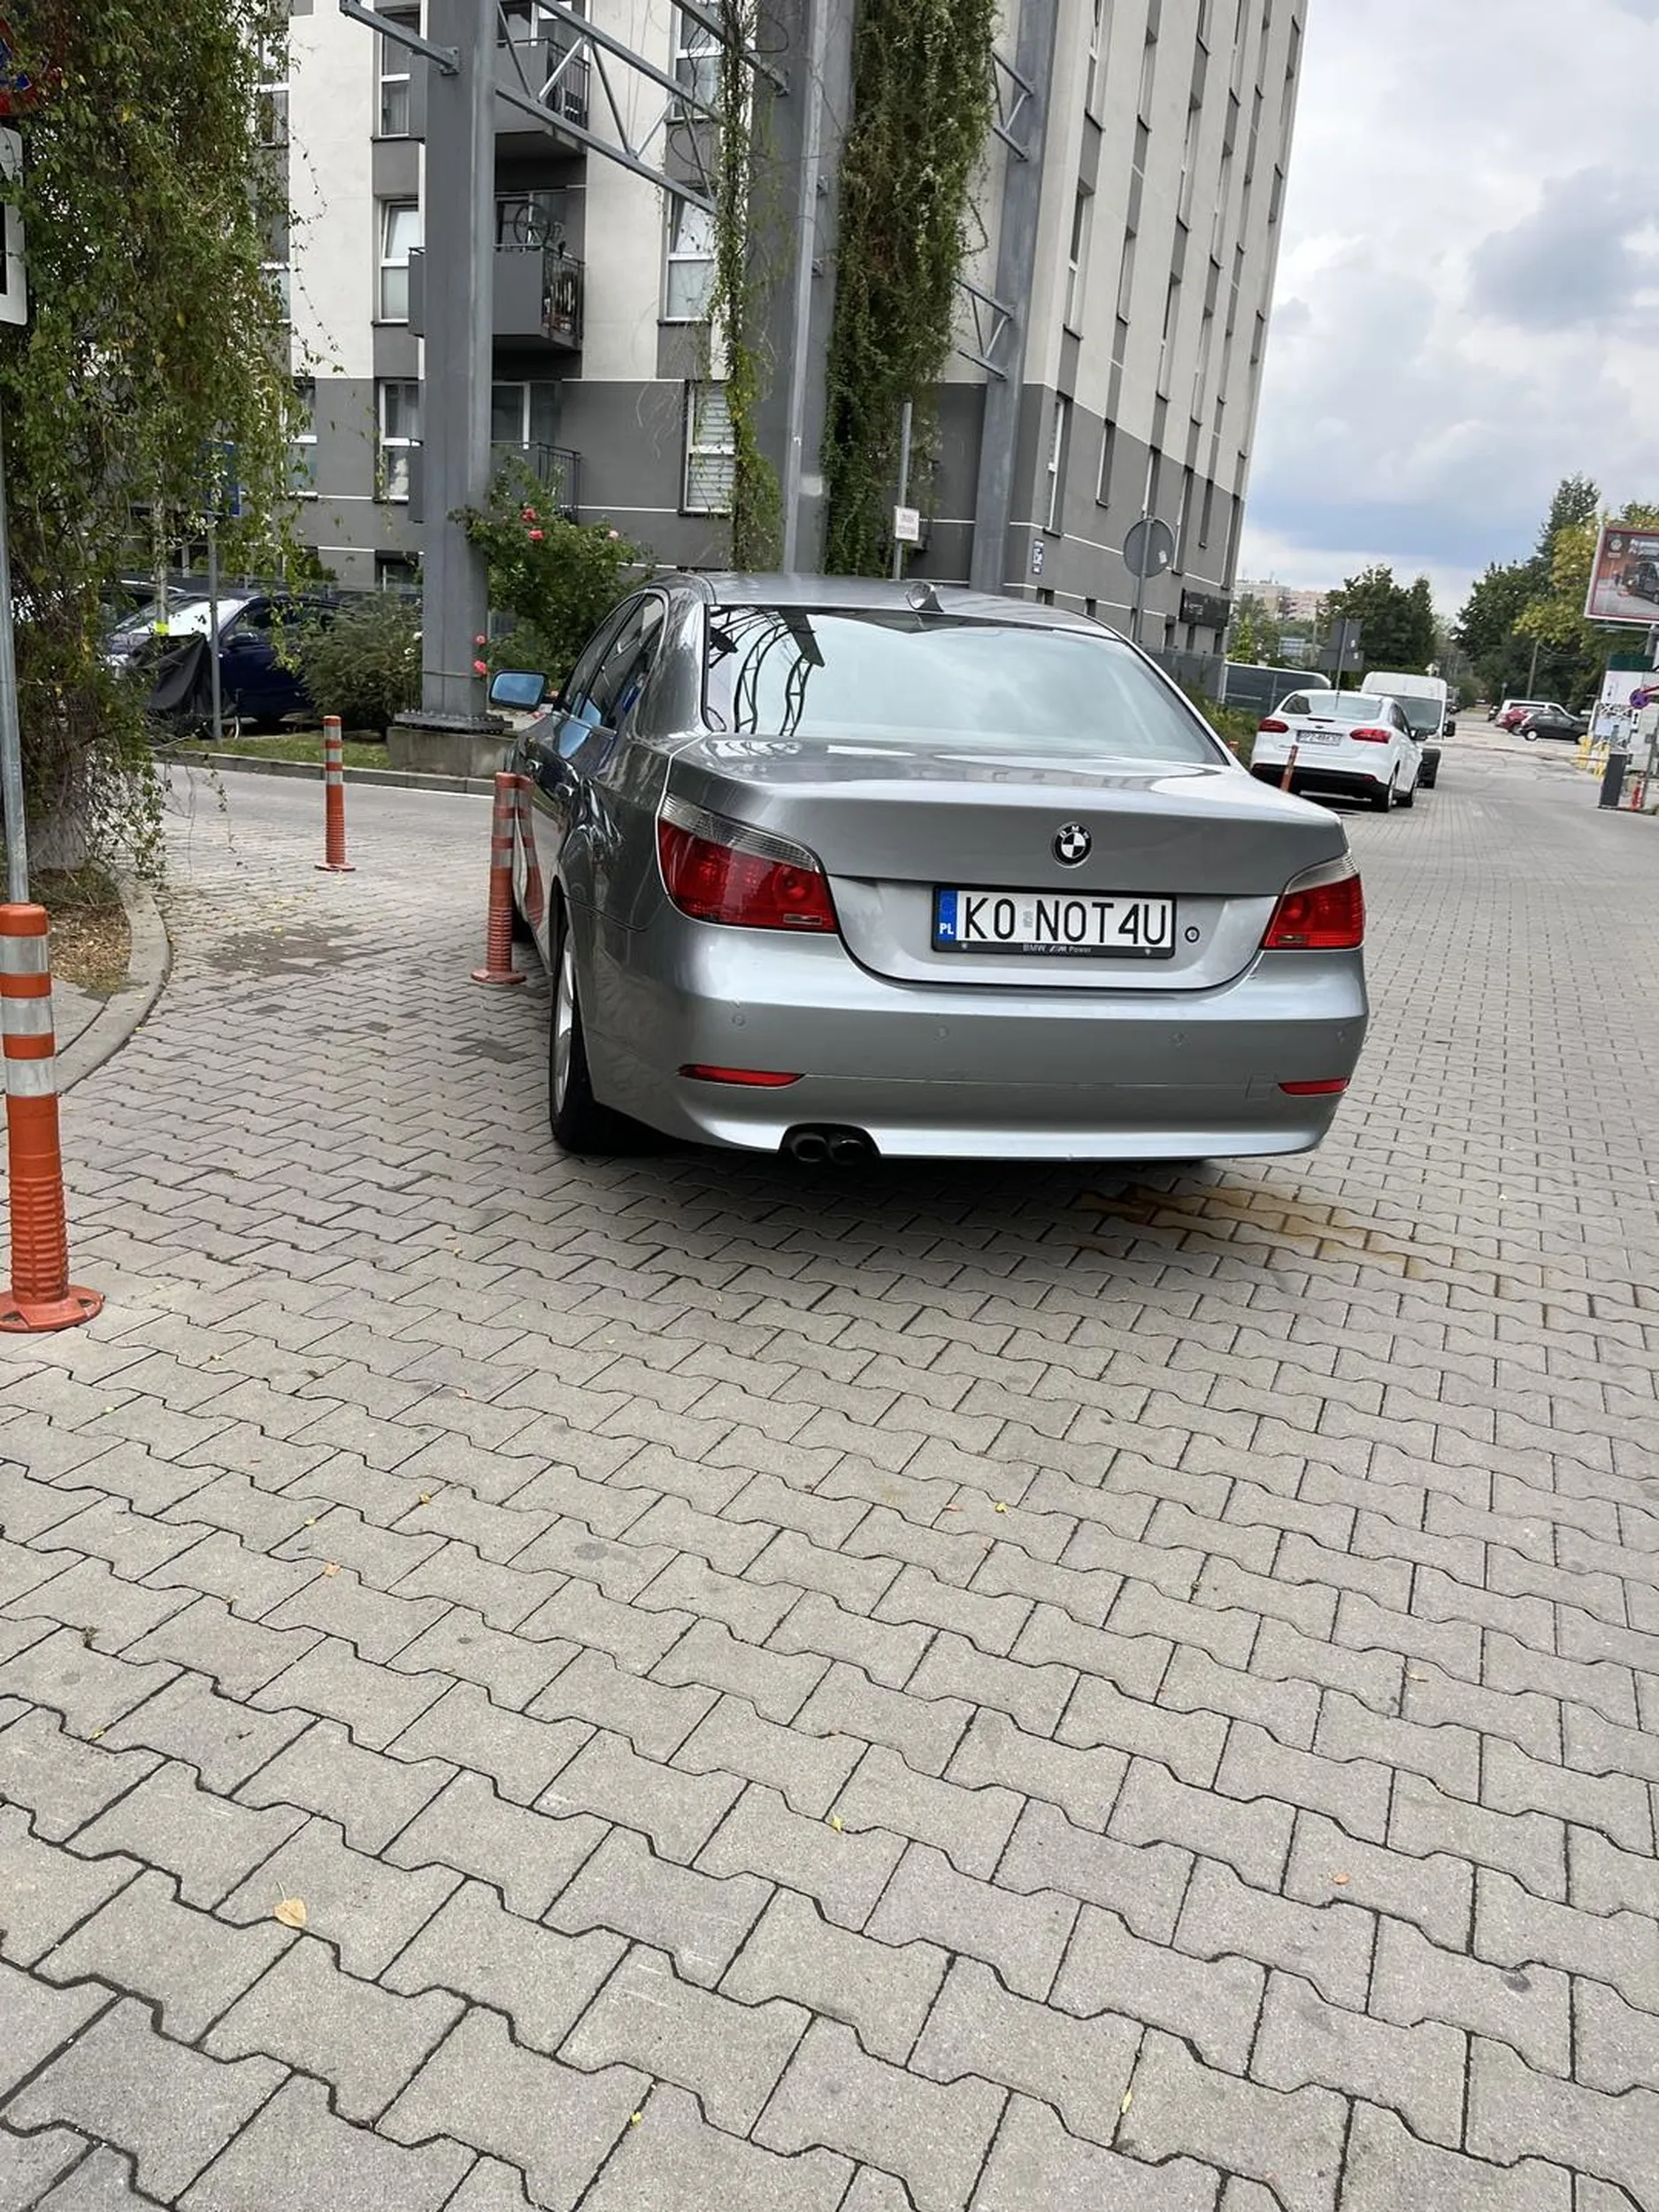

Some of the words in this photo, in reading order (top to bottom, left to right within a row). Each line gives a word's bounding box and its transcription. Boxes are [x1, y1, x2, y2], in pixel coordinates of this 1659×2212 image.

[1035, 899, 1166, 945] NOT4U
[939, 923, 954, 934] PL
[1023, 942, 1046, 952] BMW
